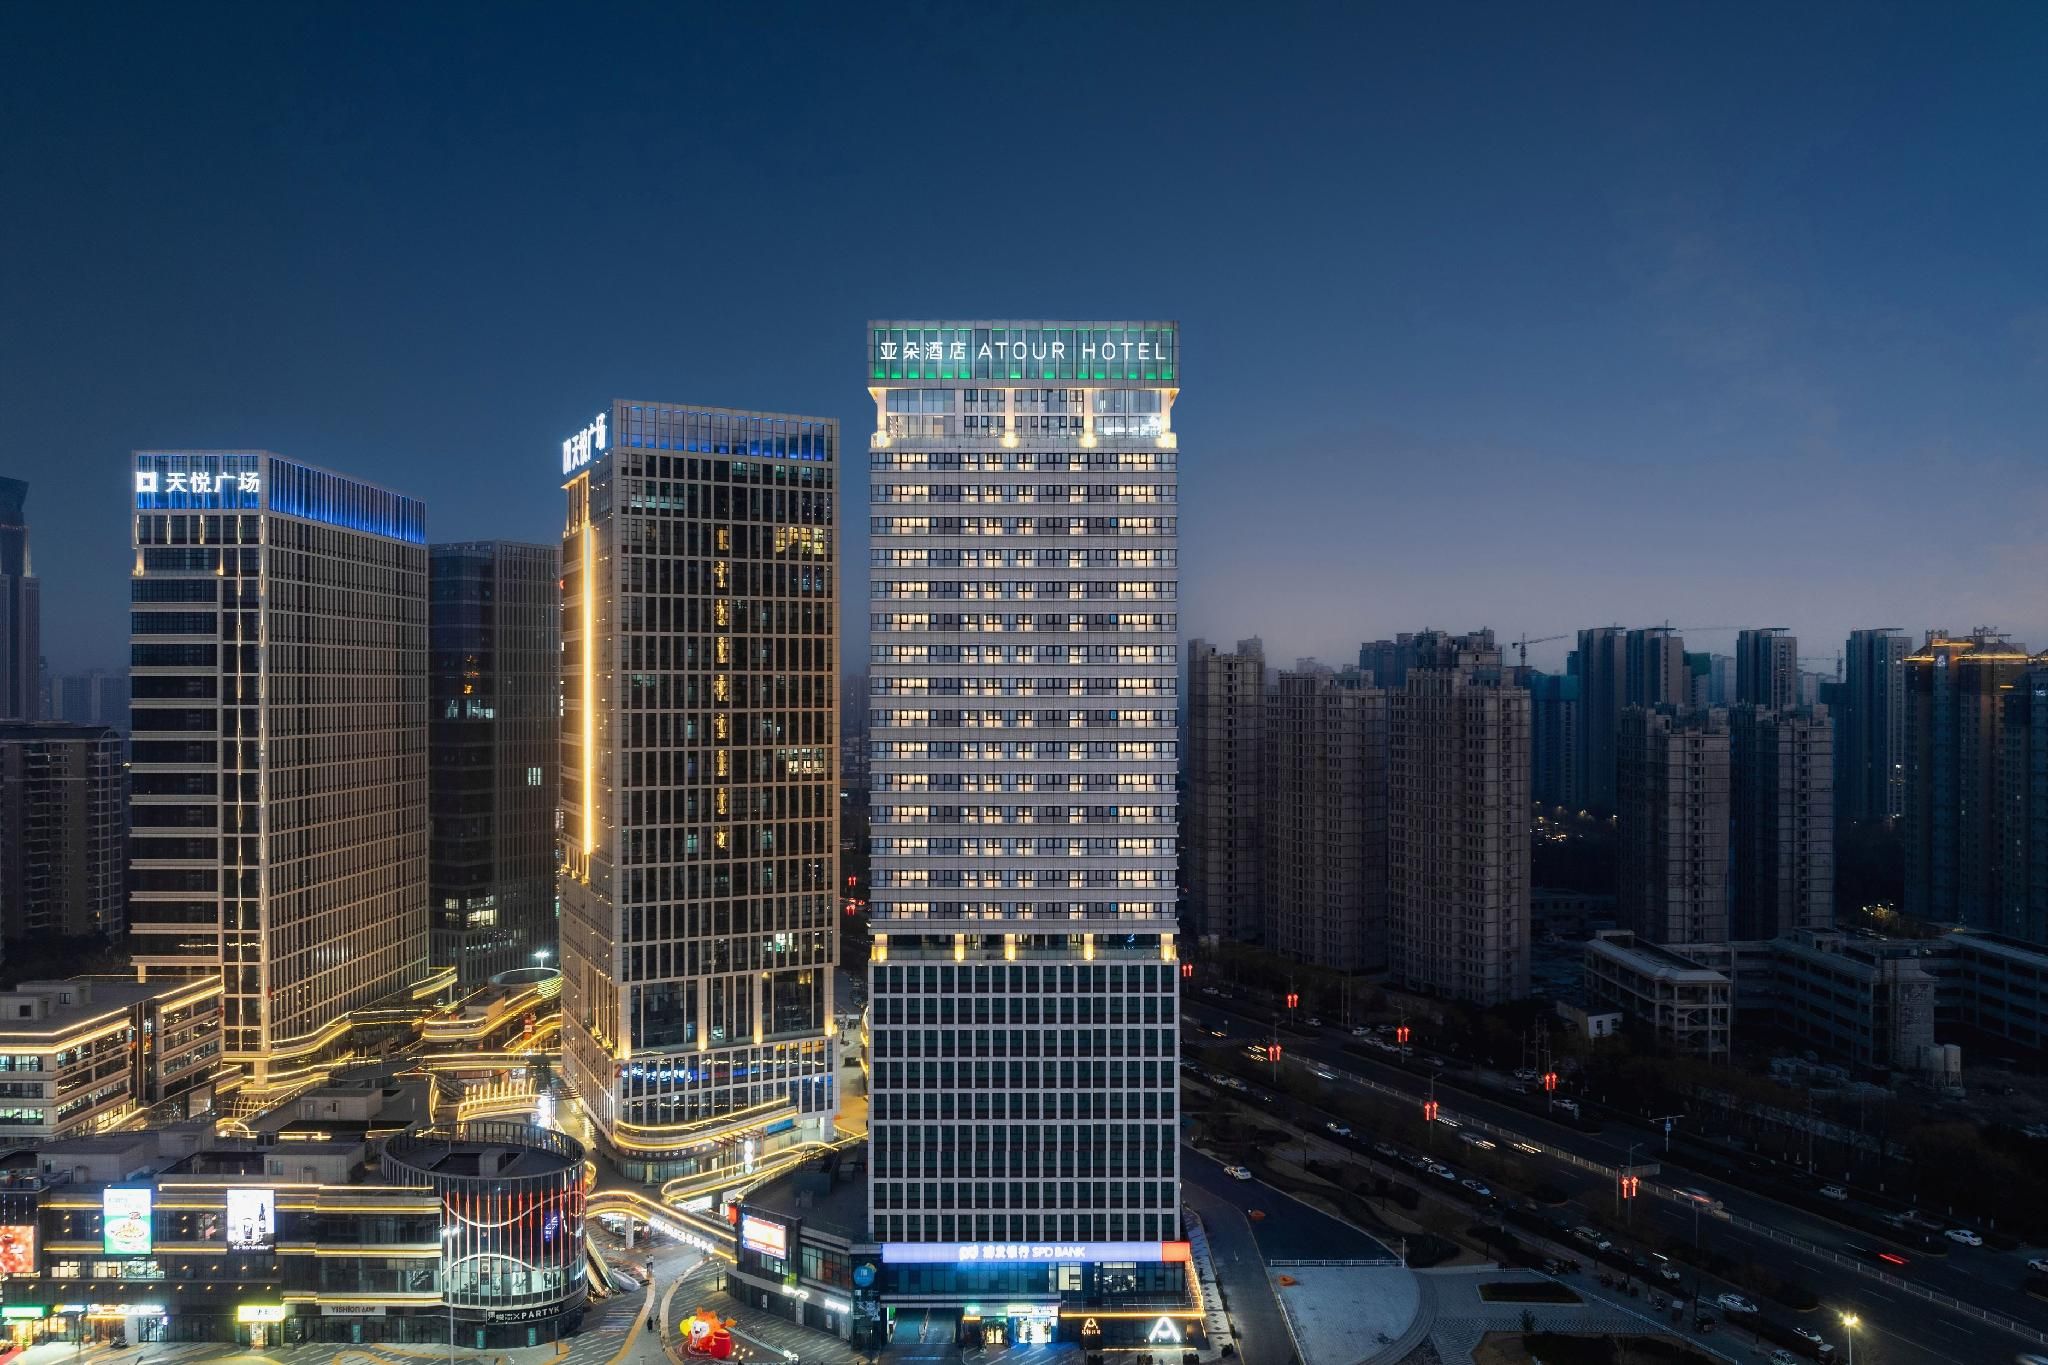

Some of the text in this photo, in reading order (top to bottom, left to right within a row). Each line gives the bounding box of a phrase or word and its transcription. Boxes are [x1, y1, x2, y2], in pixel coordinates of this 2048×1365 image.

[880, 341, 966, 360] 亚朵酒店
[978, 341, 1167, 360] ATOUR HOTEL
[166, 471, 260, 493] 天悦广场
[1032, 1246, 1086, 1258] SPD BANK
[521, 1306, 560, 1320] PARTYK
